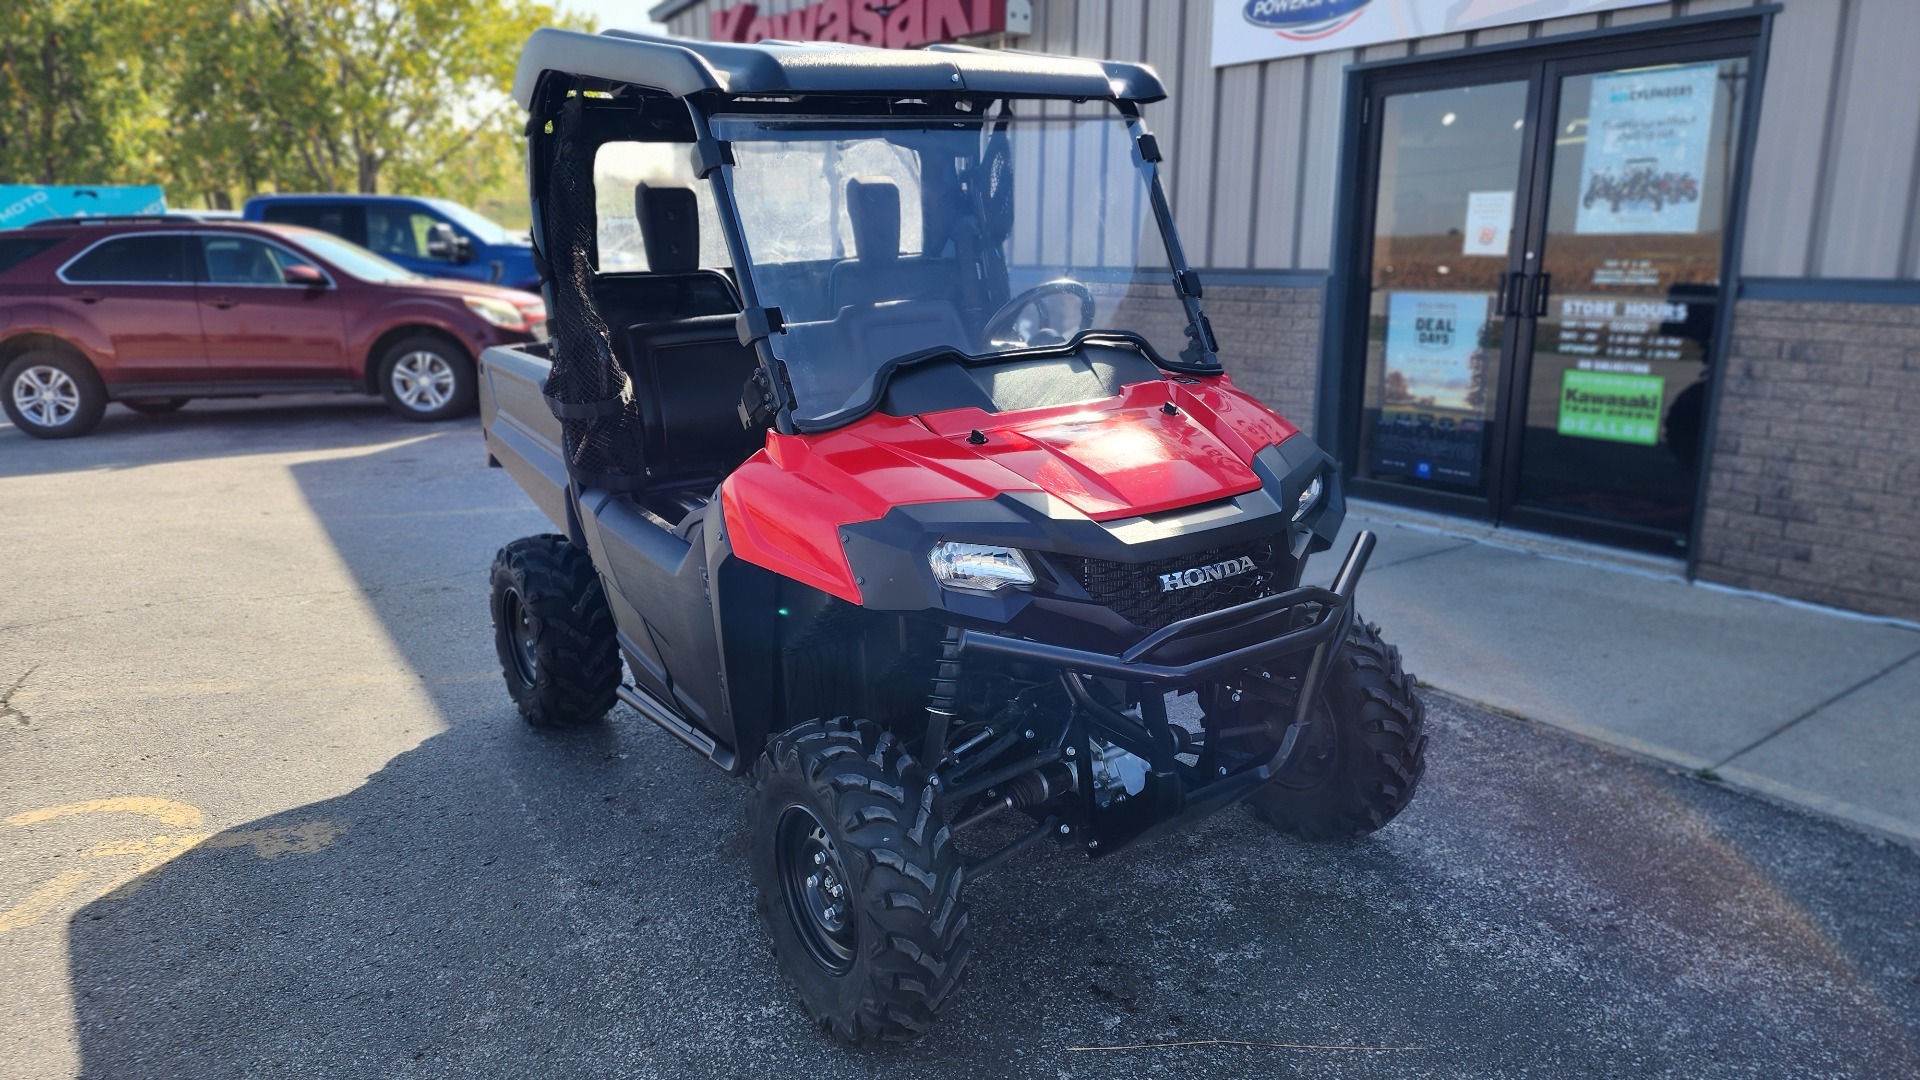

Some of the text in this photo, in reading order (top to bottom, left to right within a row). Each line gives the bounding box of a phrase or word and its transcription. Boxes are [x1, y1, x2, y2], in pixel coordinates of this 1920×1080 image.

[1563, 300, 1688, 322] STORE HOURS
[1415, 317, 1455, 333] DEAL
[1419, 331, 1450, 345] DAYS
[1565, 387, 1658, 410] Kawasaki
[1561, 417, 1654, 440] DEALER
[1158, 555, 1258, 593] HONDA
